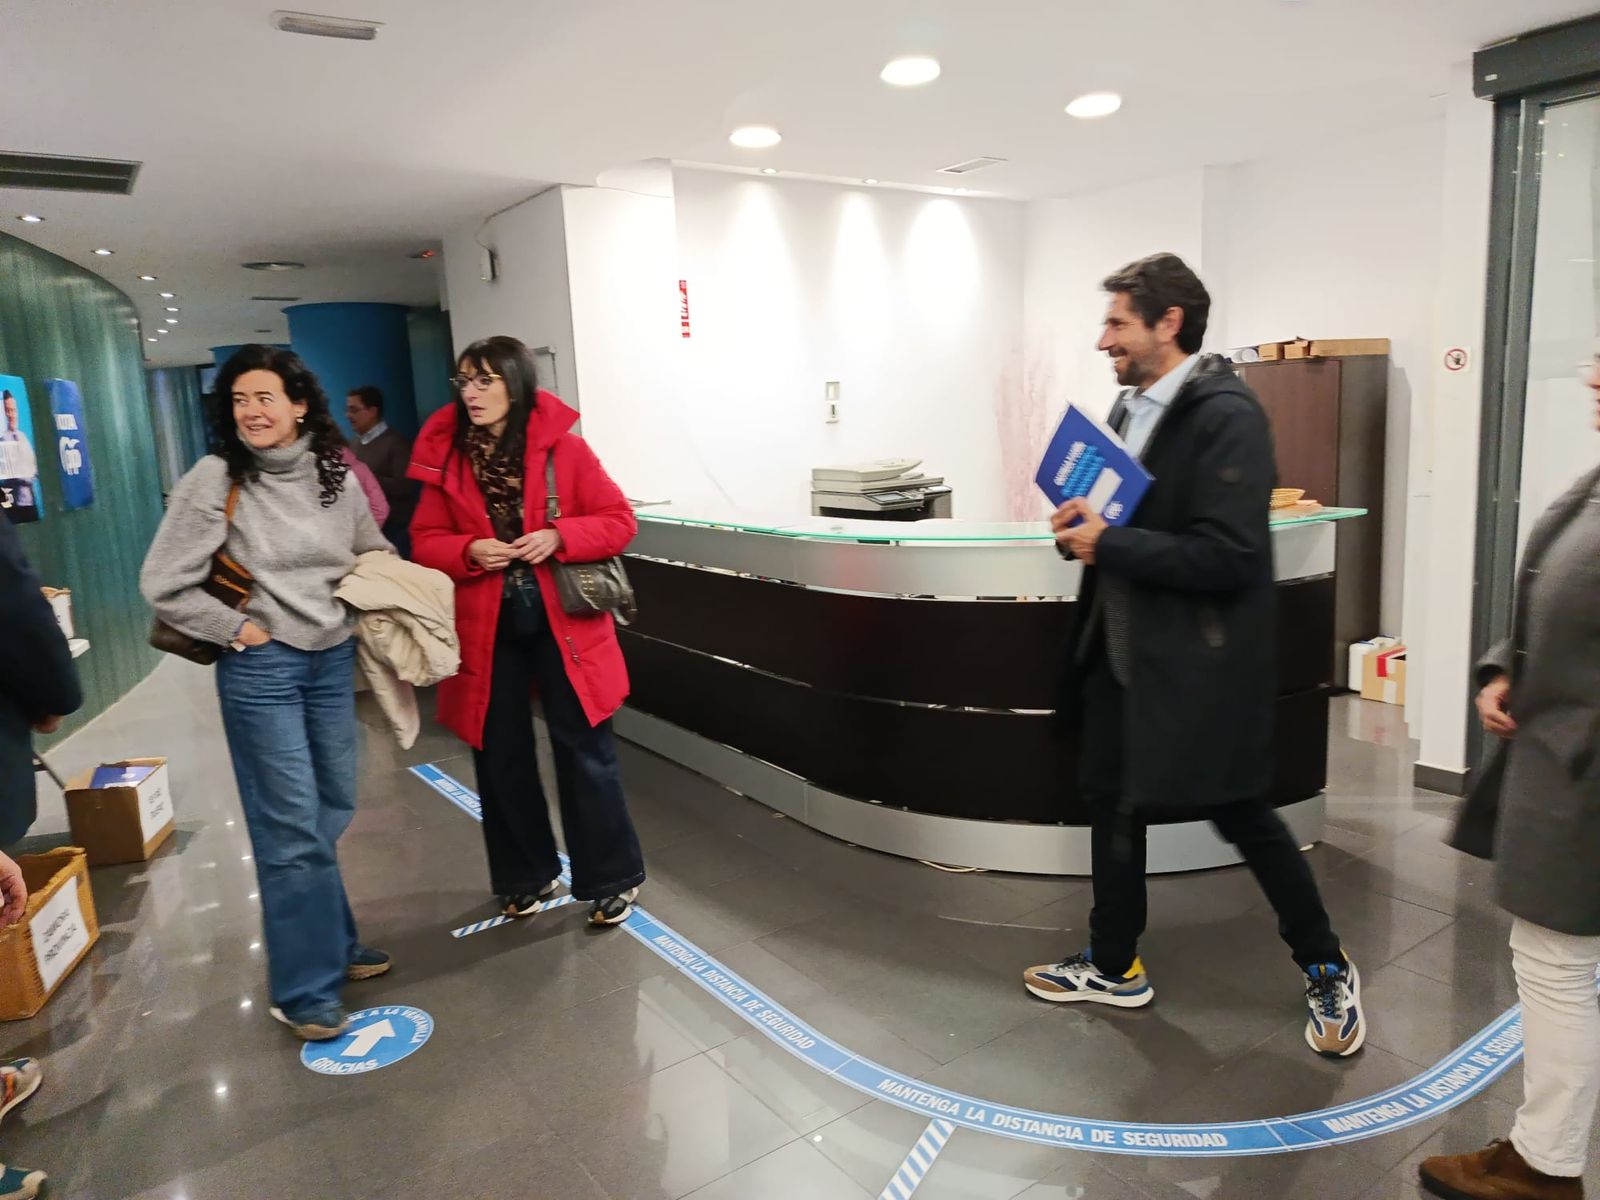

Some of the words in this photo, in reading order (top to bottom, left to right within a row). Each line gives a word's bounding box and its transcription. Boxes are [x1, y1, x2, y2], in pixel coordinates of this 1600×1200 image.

[652, 934, 695, 965] MANTENGA
[691, 957, 707, 972] LA
[702, 969, 749, 1003] DISTANCIA
[744, 999, 763, 1012] DE
[757, 1008, 816, 1050] SEGURIDAD
[310, 1057, 379, 1074] GRACIAS
[1322, 1100, 1413, 1134] MANTENGA
[1400, 1096, 1432, 1109] LA
[1424, 1062, 1487, 1100] DISTANCIA
[1468, 1051, 1498, 1067] DE
[876, 1077, 960, 1117] MANTENGA
[964, 1105, 986, 1123] LA
[991, 1113, 1084, 1142] DISTANCIA
[1090, 1129, 1117, 1145] DE
[1121, 1130, 1229, 1148] SEGURIDAD
